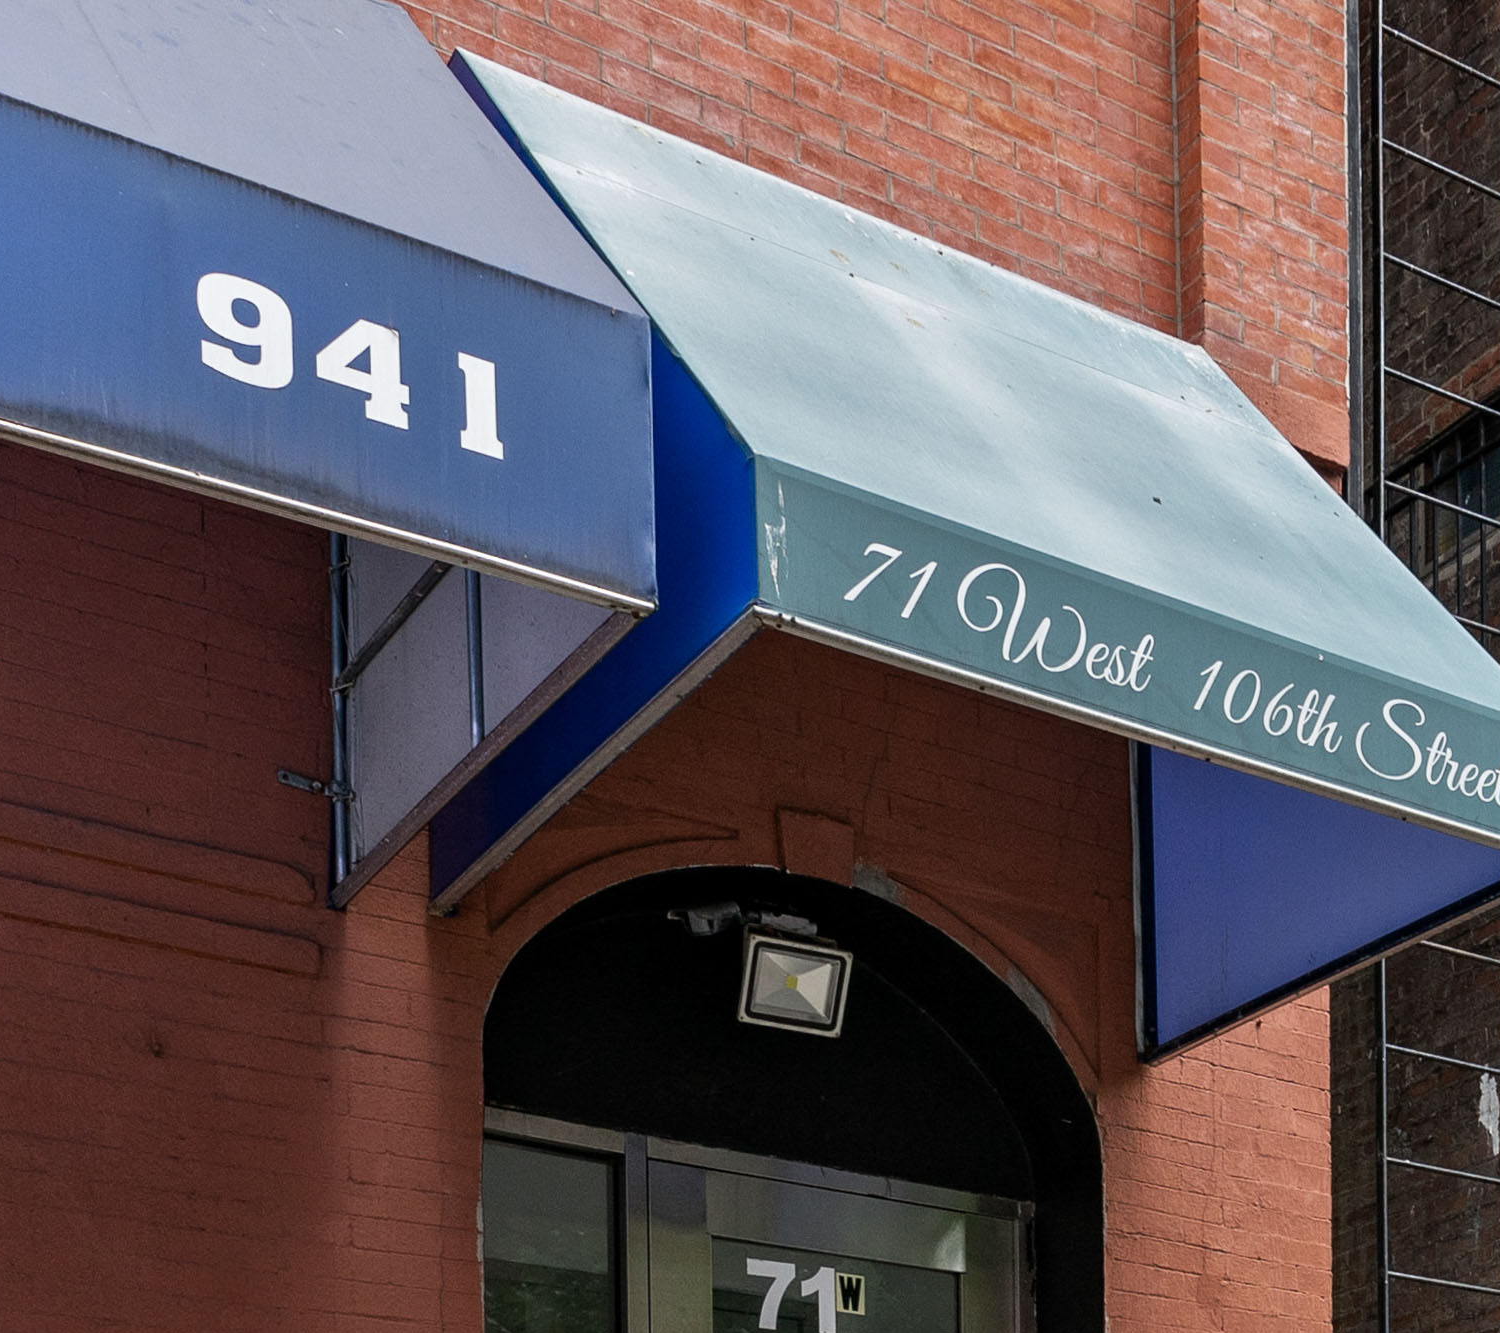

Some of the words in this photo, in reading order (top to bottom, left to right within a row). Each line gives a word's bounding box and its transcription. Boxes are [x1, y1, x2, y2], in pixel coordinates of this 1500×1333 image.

[195, 272, 505, 460] 941
[843, 542, 939, 620] 71
[956, 563, 1155, 693] West
[1193, 659, 1343, 753] 106th
